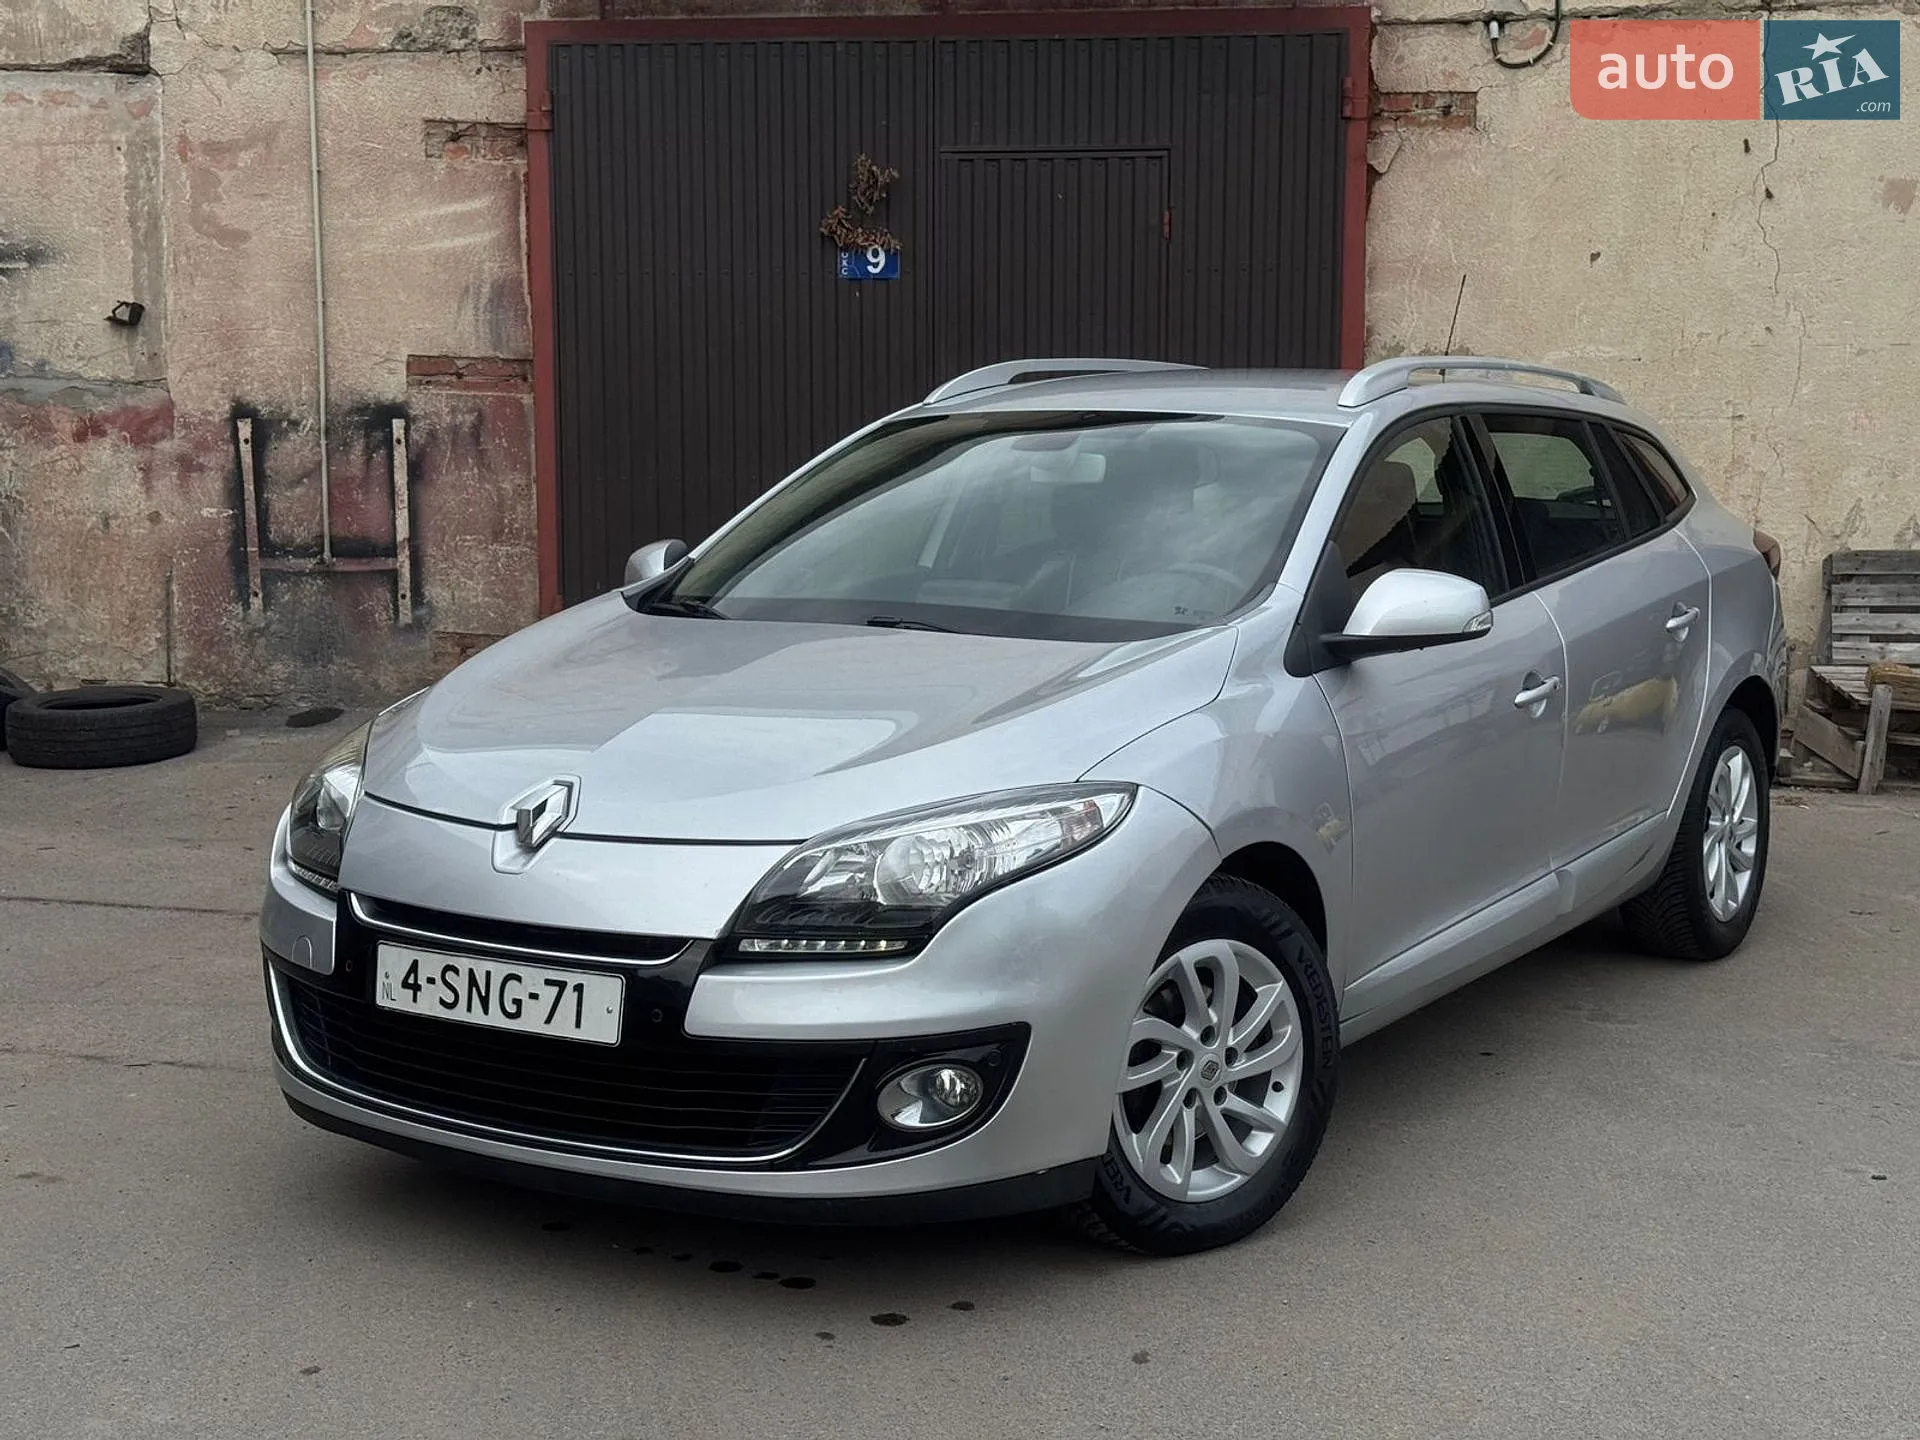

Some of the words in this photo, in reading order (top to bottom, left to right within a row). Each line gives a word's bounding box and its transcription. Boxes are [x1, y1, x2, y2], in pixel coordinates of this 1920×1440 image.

[866, 245, 885, 273] 9
[382, 980, 397, 1001] NL
[401, 959, 584, 1029] 4-SNG-71
